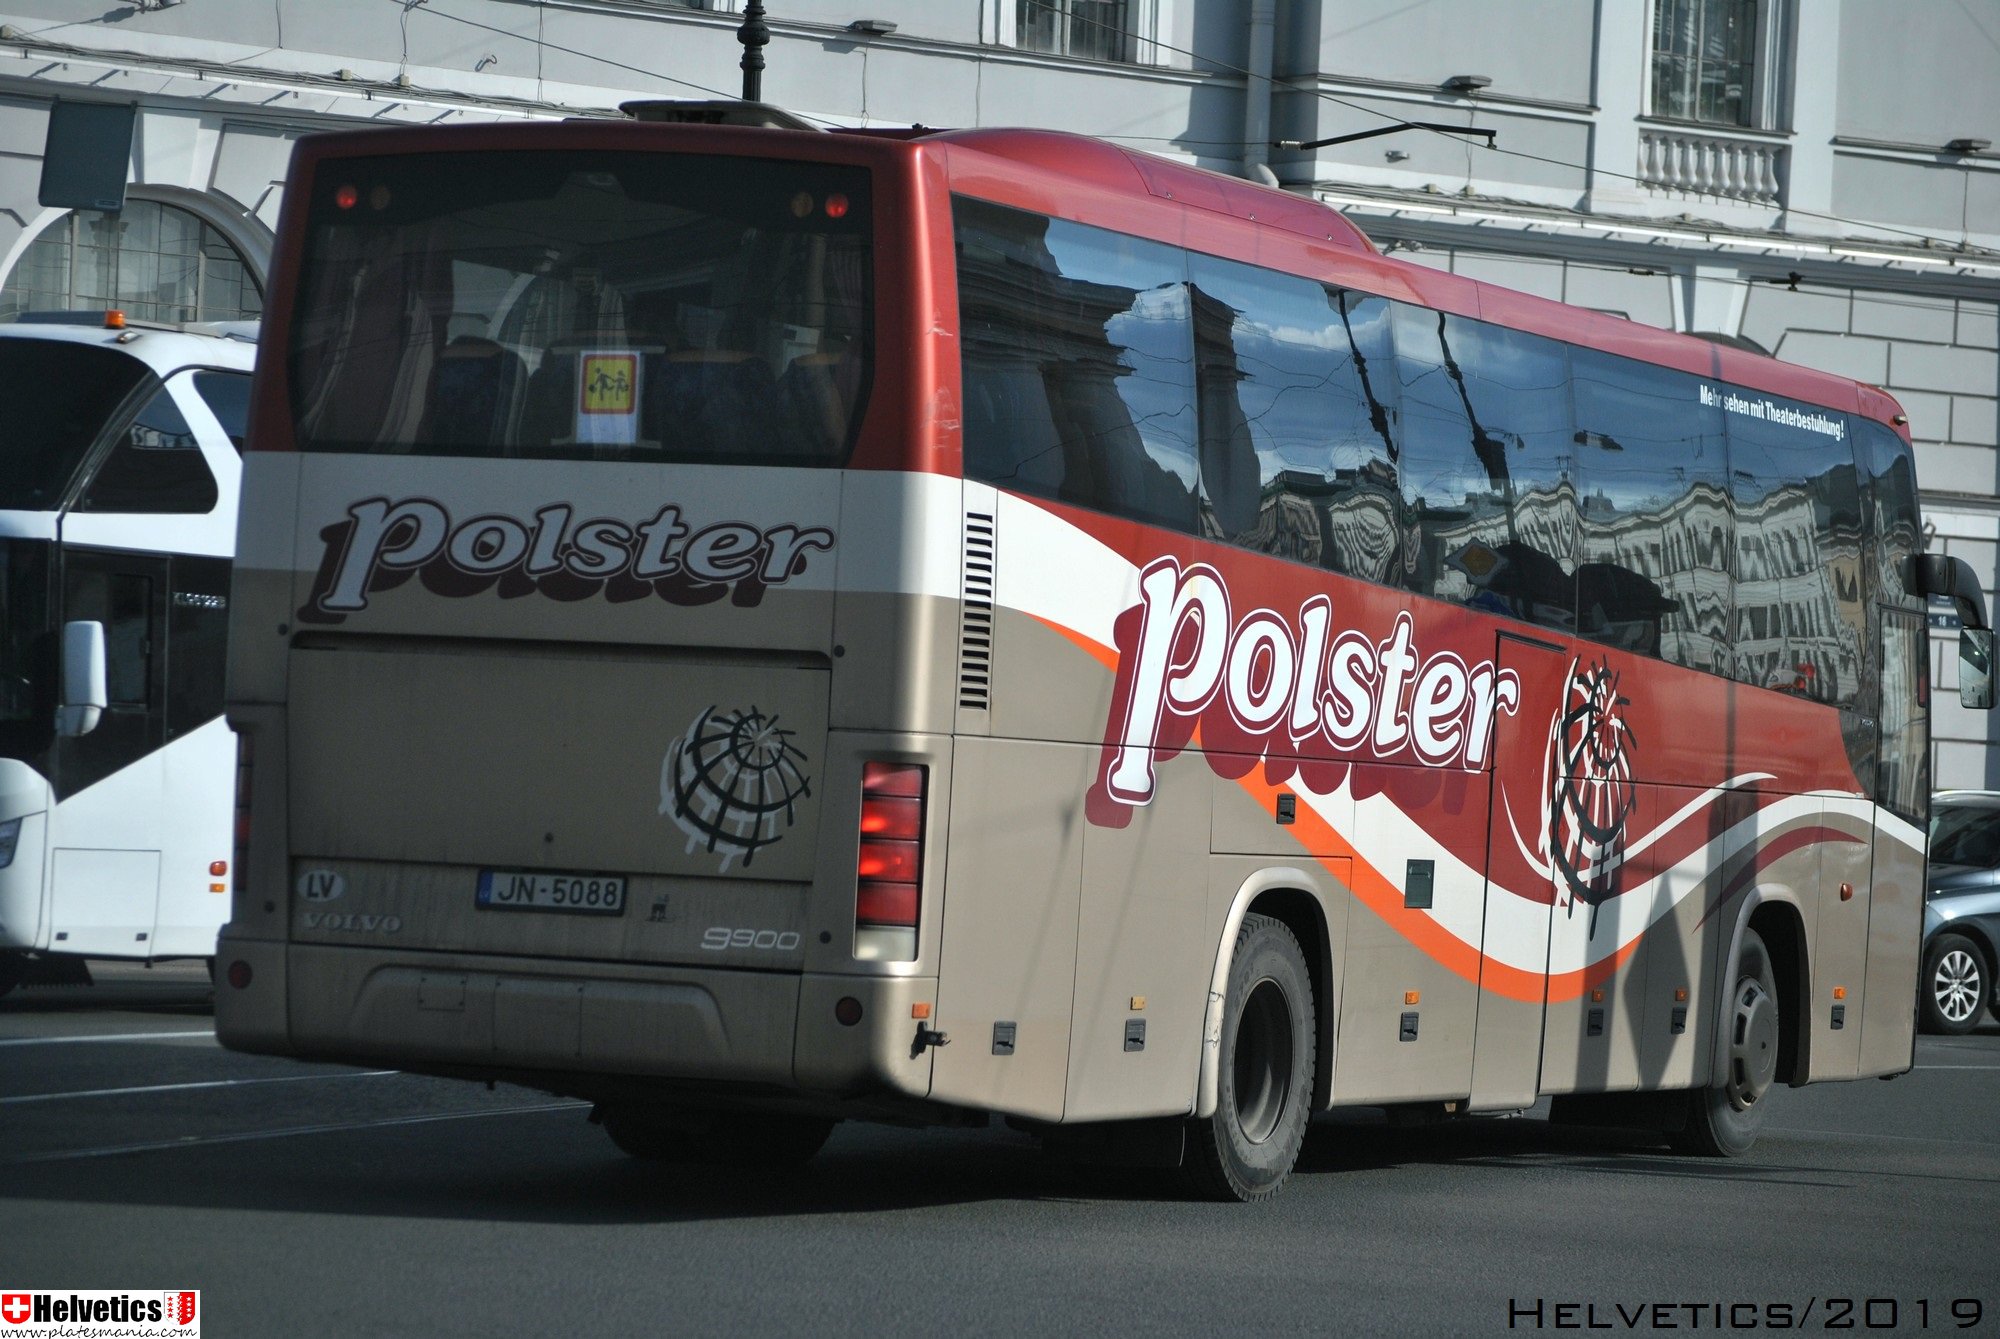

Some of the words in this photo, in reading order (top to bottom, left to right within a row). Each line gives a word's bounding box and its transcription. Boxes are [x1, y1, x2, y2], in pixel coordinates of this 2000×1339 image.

[1700, 384, 1722, 408] Mehr
[1723, 393, 1750, 415] sehen
[1750, 399, 1765, 419] mit
[1765, 400, 1845, 442] Theaterbestuhlung!
[307, 873, 335, 898] LV
[498, 875, 618, 907] JN-5088
[302, 912, 402, 933] VOLVO
[700, 927, 800, 950] 9900
